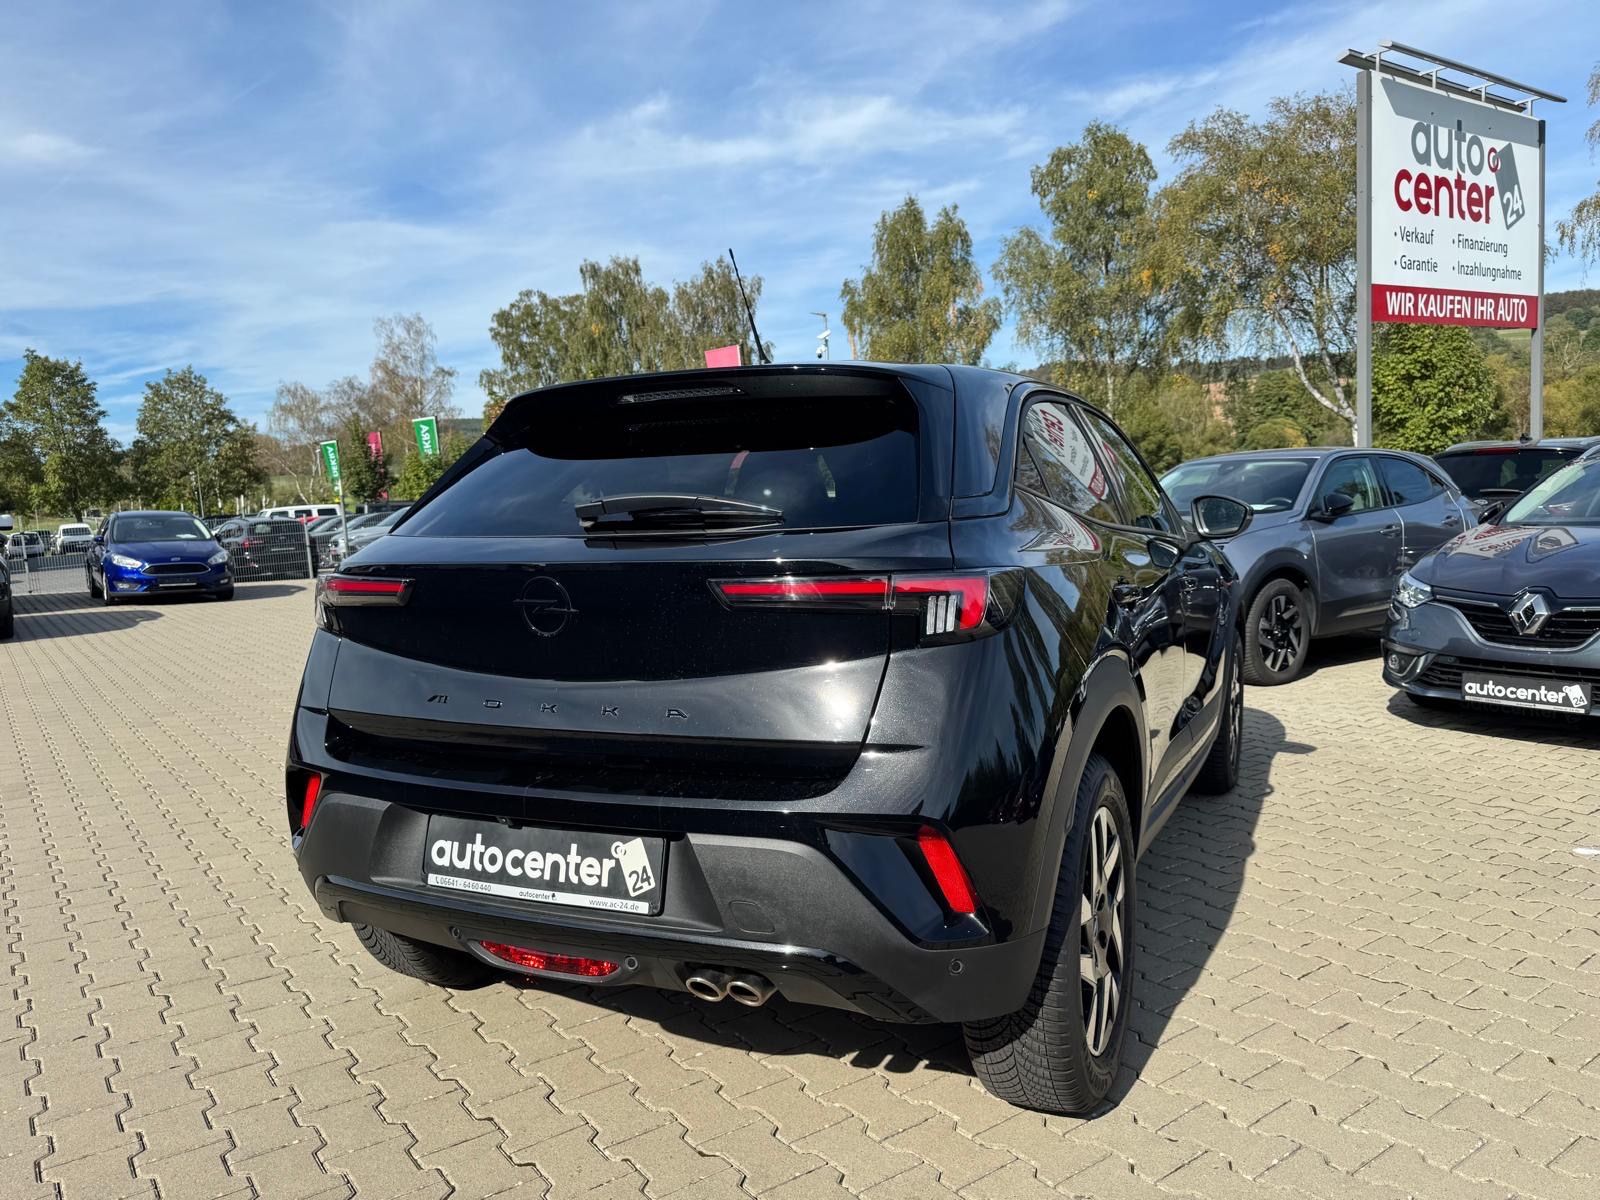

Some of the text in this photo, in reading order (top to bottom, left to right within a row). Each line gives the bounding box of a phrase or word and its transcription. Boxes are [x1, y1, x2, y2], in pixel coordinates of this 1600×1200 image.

[1411, 120, 1485, 176] auto
[1394, 168, 1494, 225] center
[1503, 184, 1523, 225] 24
[1399, 226, 1434, 245] Verkauf
[1457, 233, 1508, 257] Finanzierung
[1399, 254, 1438, 273] Garantie
[1457, 260, 1522, 281] Inzahlungnahme
[1386, 291, 1528, 323] WIR KAUFEN IHR AUTO
[1464, 680, 1566, 704] autocenter
[1573, 696, 1585, 706] 24
[427, 694, 688, 719] MOKKA
[430, 833, 616, 888] autocenter
[628, 865, 652, 893] 24
[518, 890, 551, 901] autocenter
[588, 899, 640, 911] www.ac-24.de
